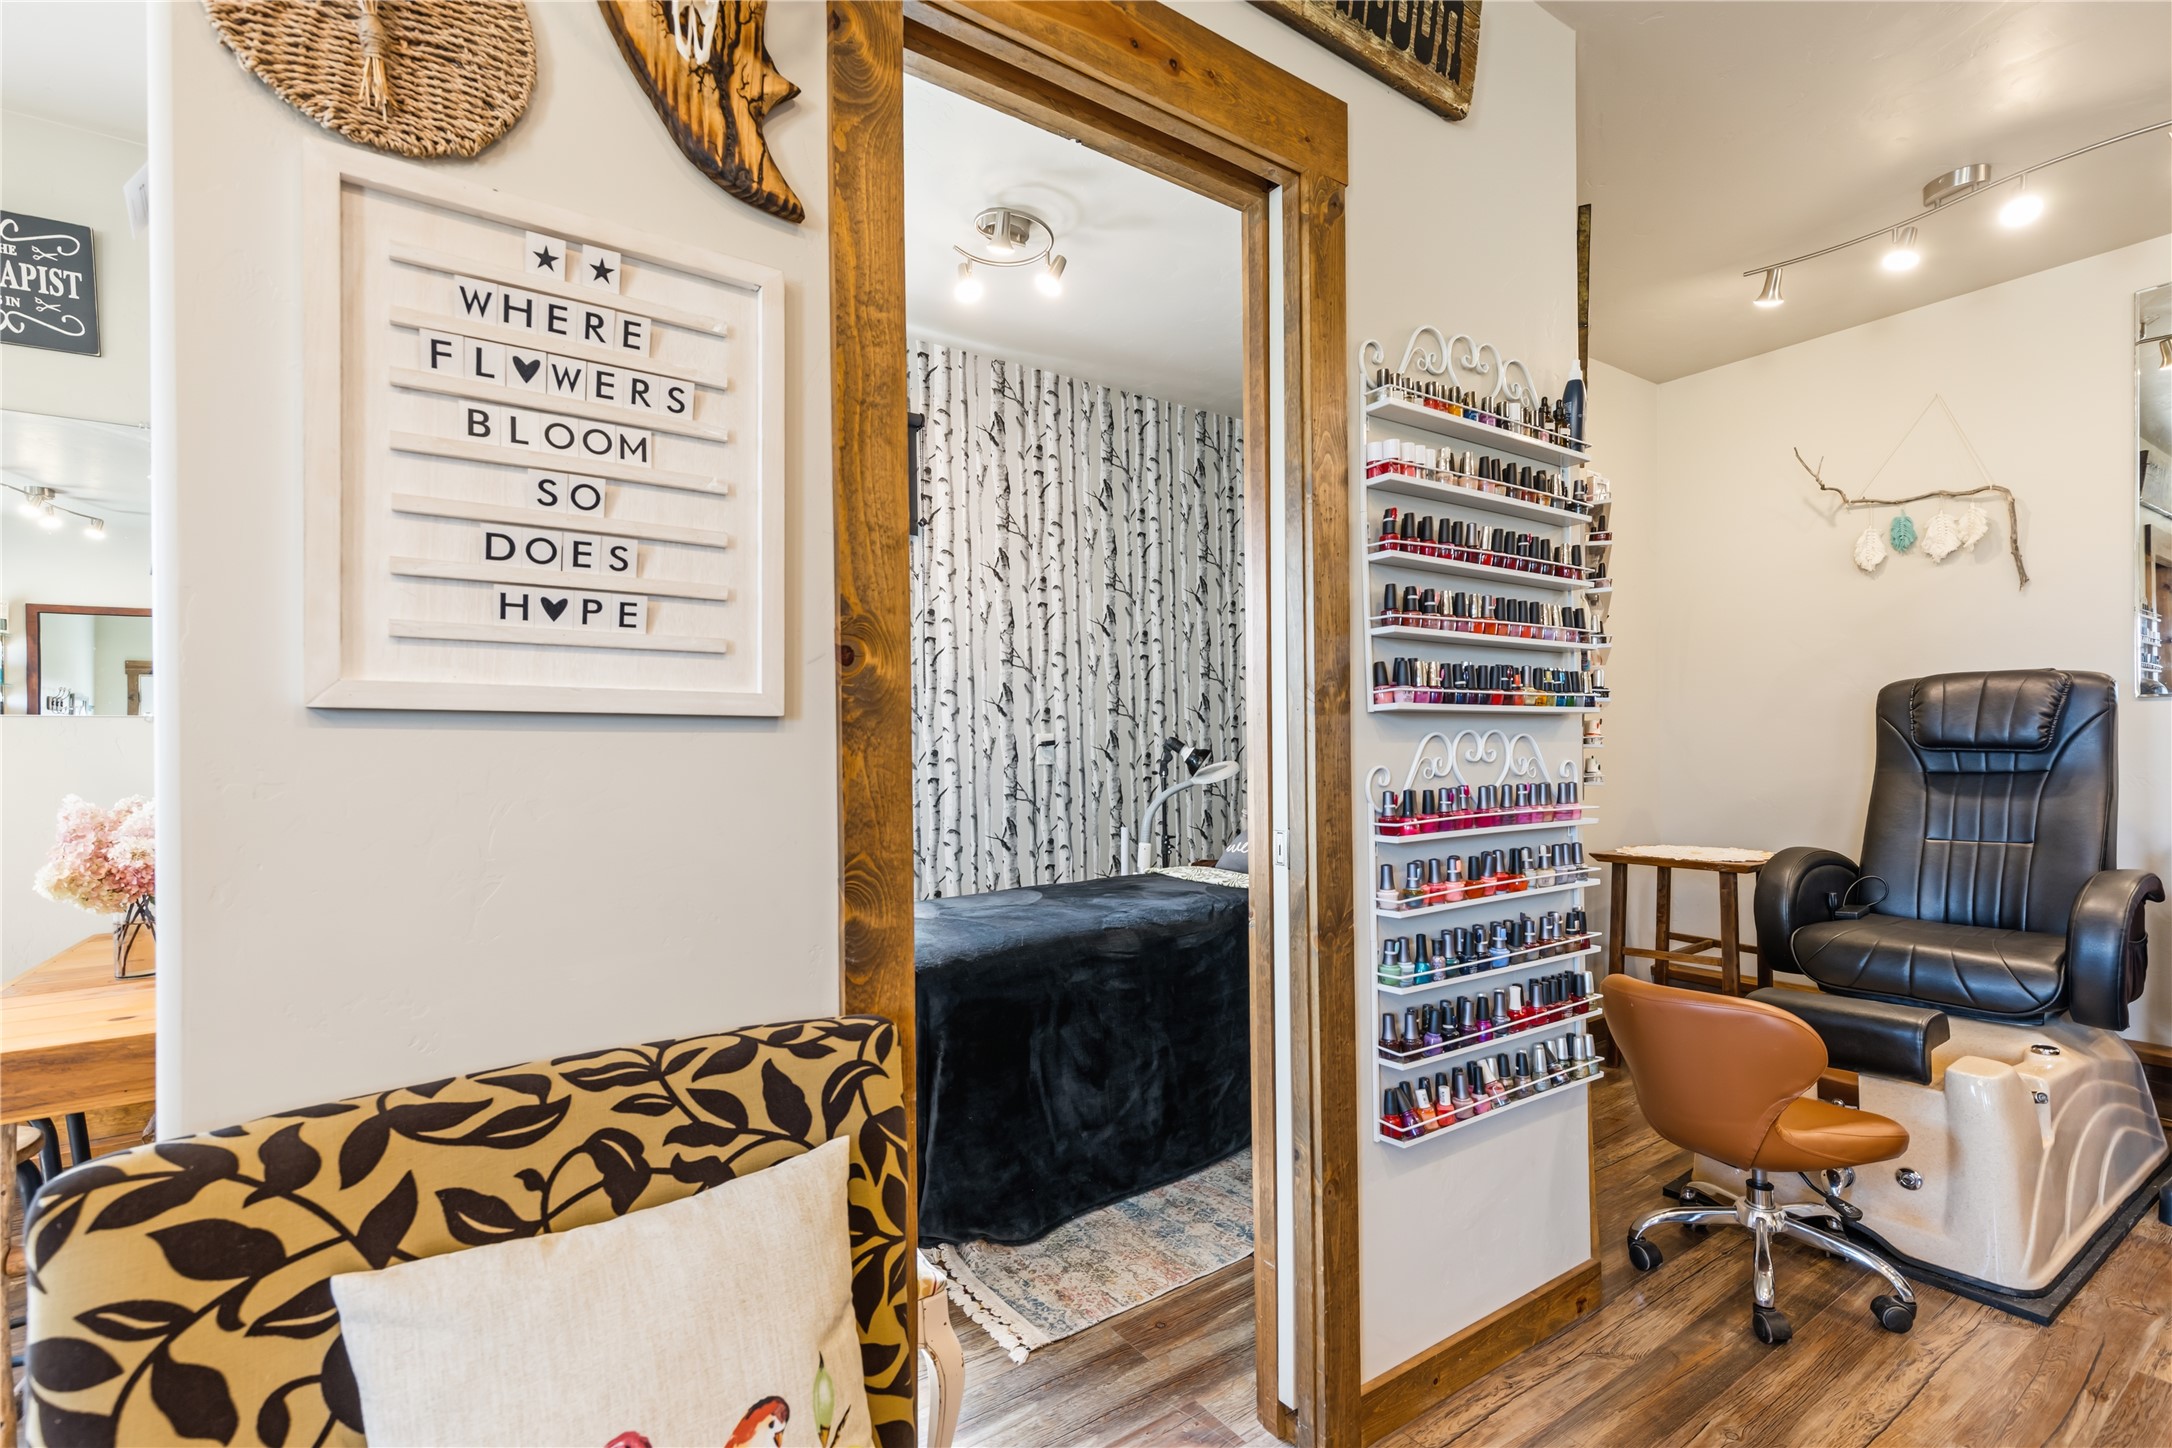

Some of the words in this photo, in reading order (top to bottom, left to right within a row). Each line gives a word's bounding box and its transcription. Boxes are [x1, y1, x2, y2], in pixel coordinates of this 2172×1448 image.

[5, 295, 20, 308] IN
[459, 285, 642, 351] WHERE
[467, 408, 648, 463] BLOOM
[537, 478, 601, 511] SO
[485, 532, 630, 572] DOES
